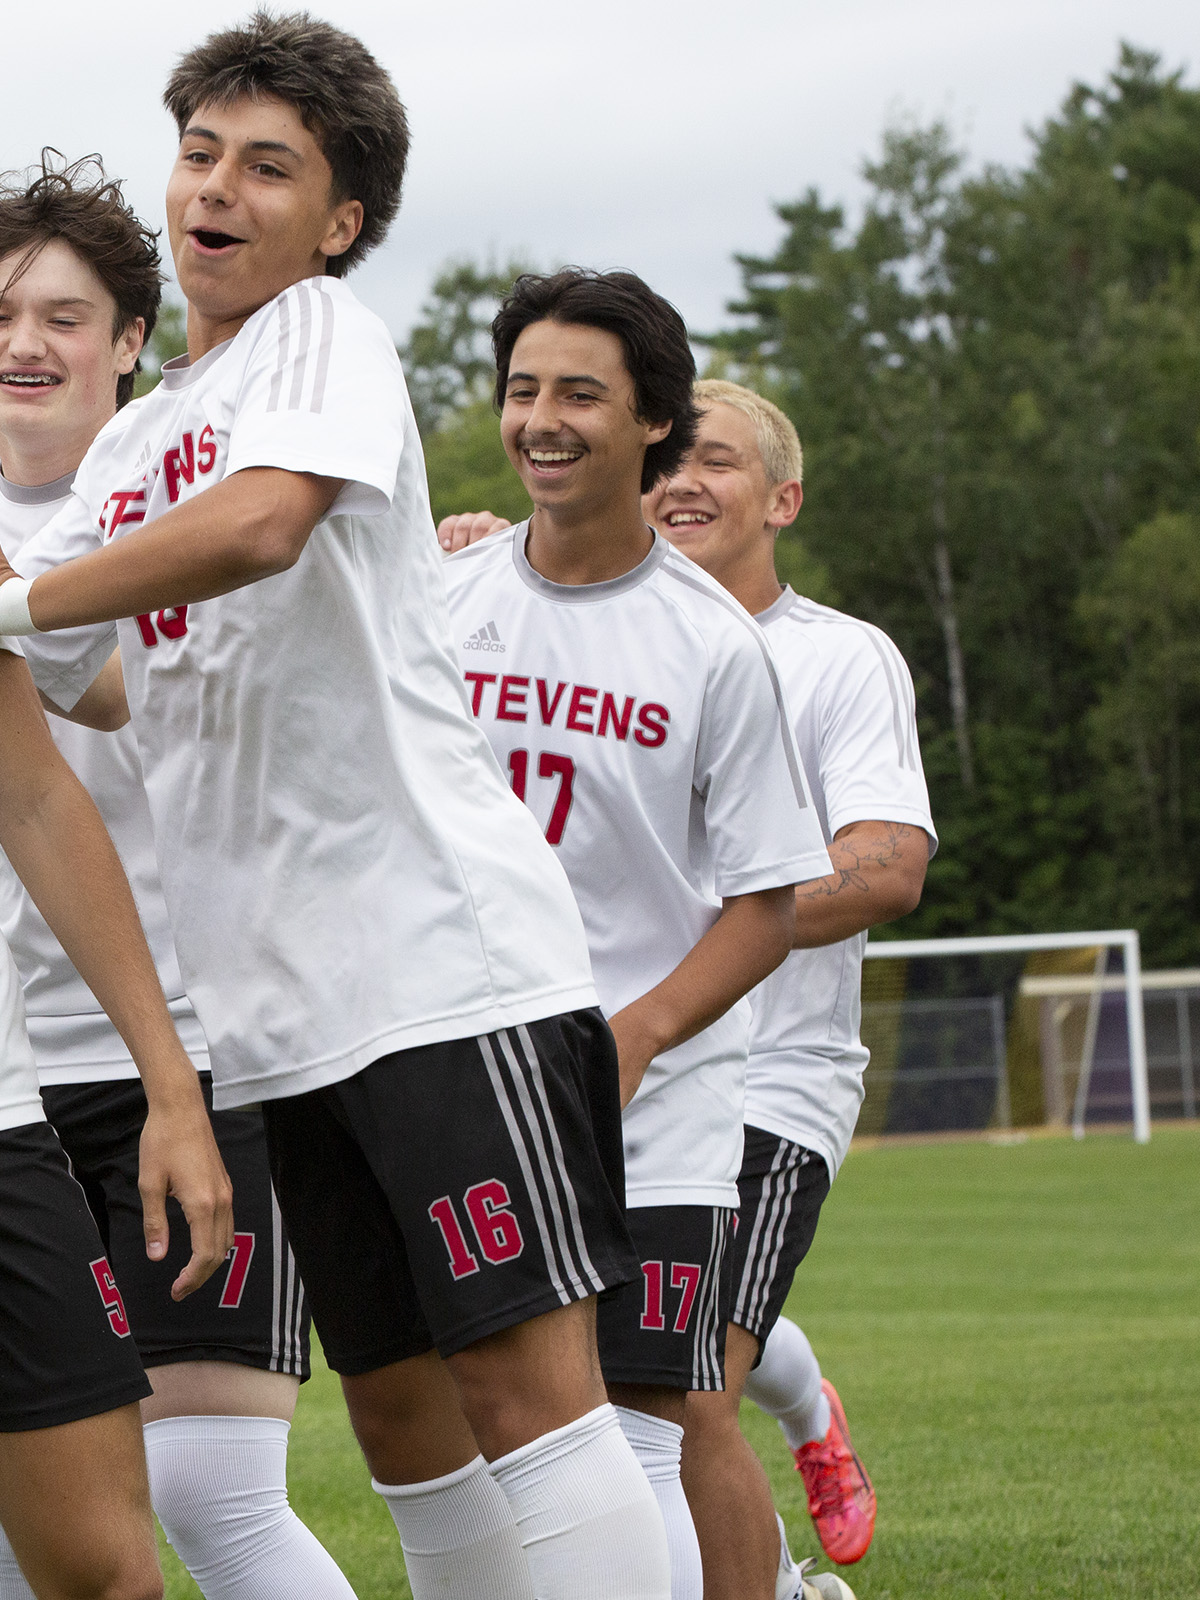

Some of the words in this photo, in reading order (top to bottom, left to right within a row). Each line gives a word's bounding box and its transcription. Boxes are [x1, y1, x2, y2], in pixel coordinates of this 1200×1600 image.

[462, 638, 507, 654] adidas
[464, 669, 671, 749] TEVENS
[507, 747, 577, 847] 17
[428, 1177, 525, 1281] 16
[88, 1256, 131, 1339] 5
[640, 1260, 702, 1333] 17
